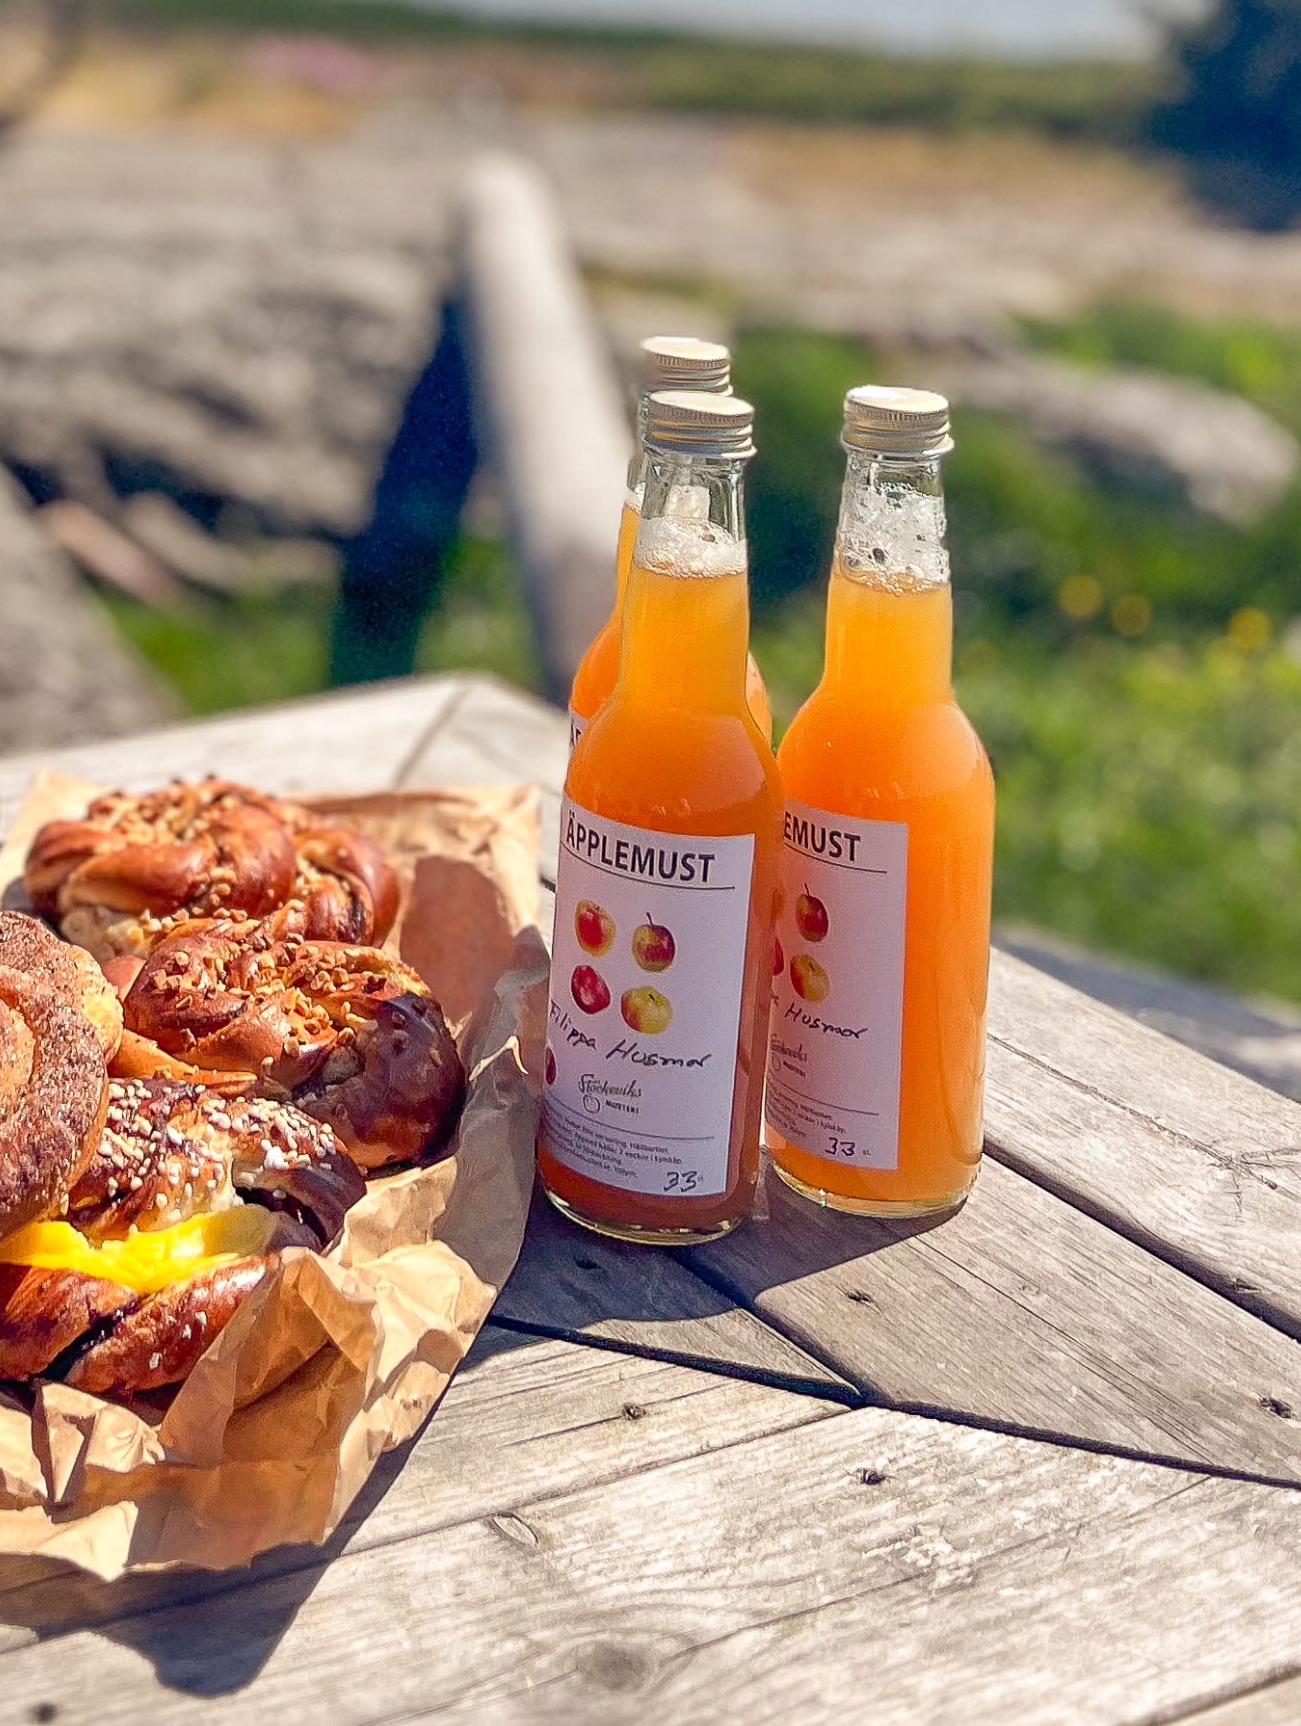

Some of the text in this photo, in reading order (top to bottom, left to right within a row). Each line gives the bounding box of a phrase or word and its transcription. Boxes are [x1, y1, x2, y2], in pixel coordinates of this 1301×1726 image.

[566, 809, 715, 883] ÄPPLEMUST
[824, 1136, 856, 1156] 33
[663, 1170, 698, 1193] 33
